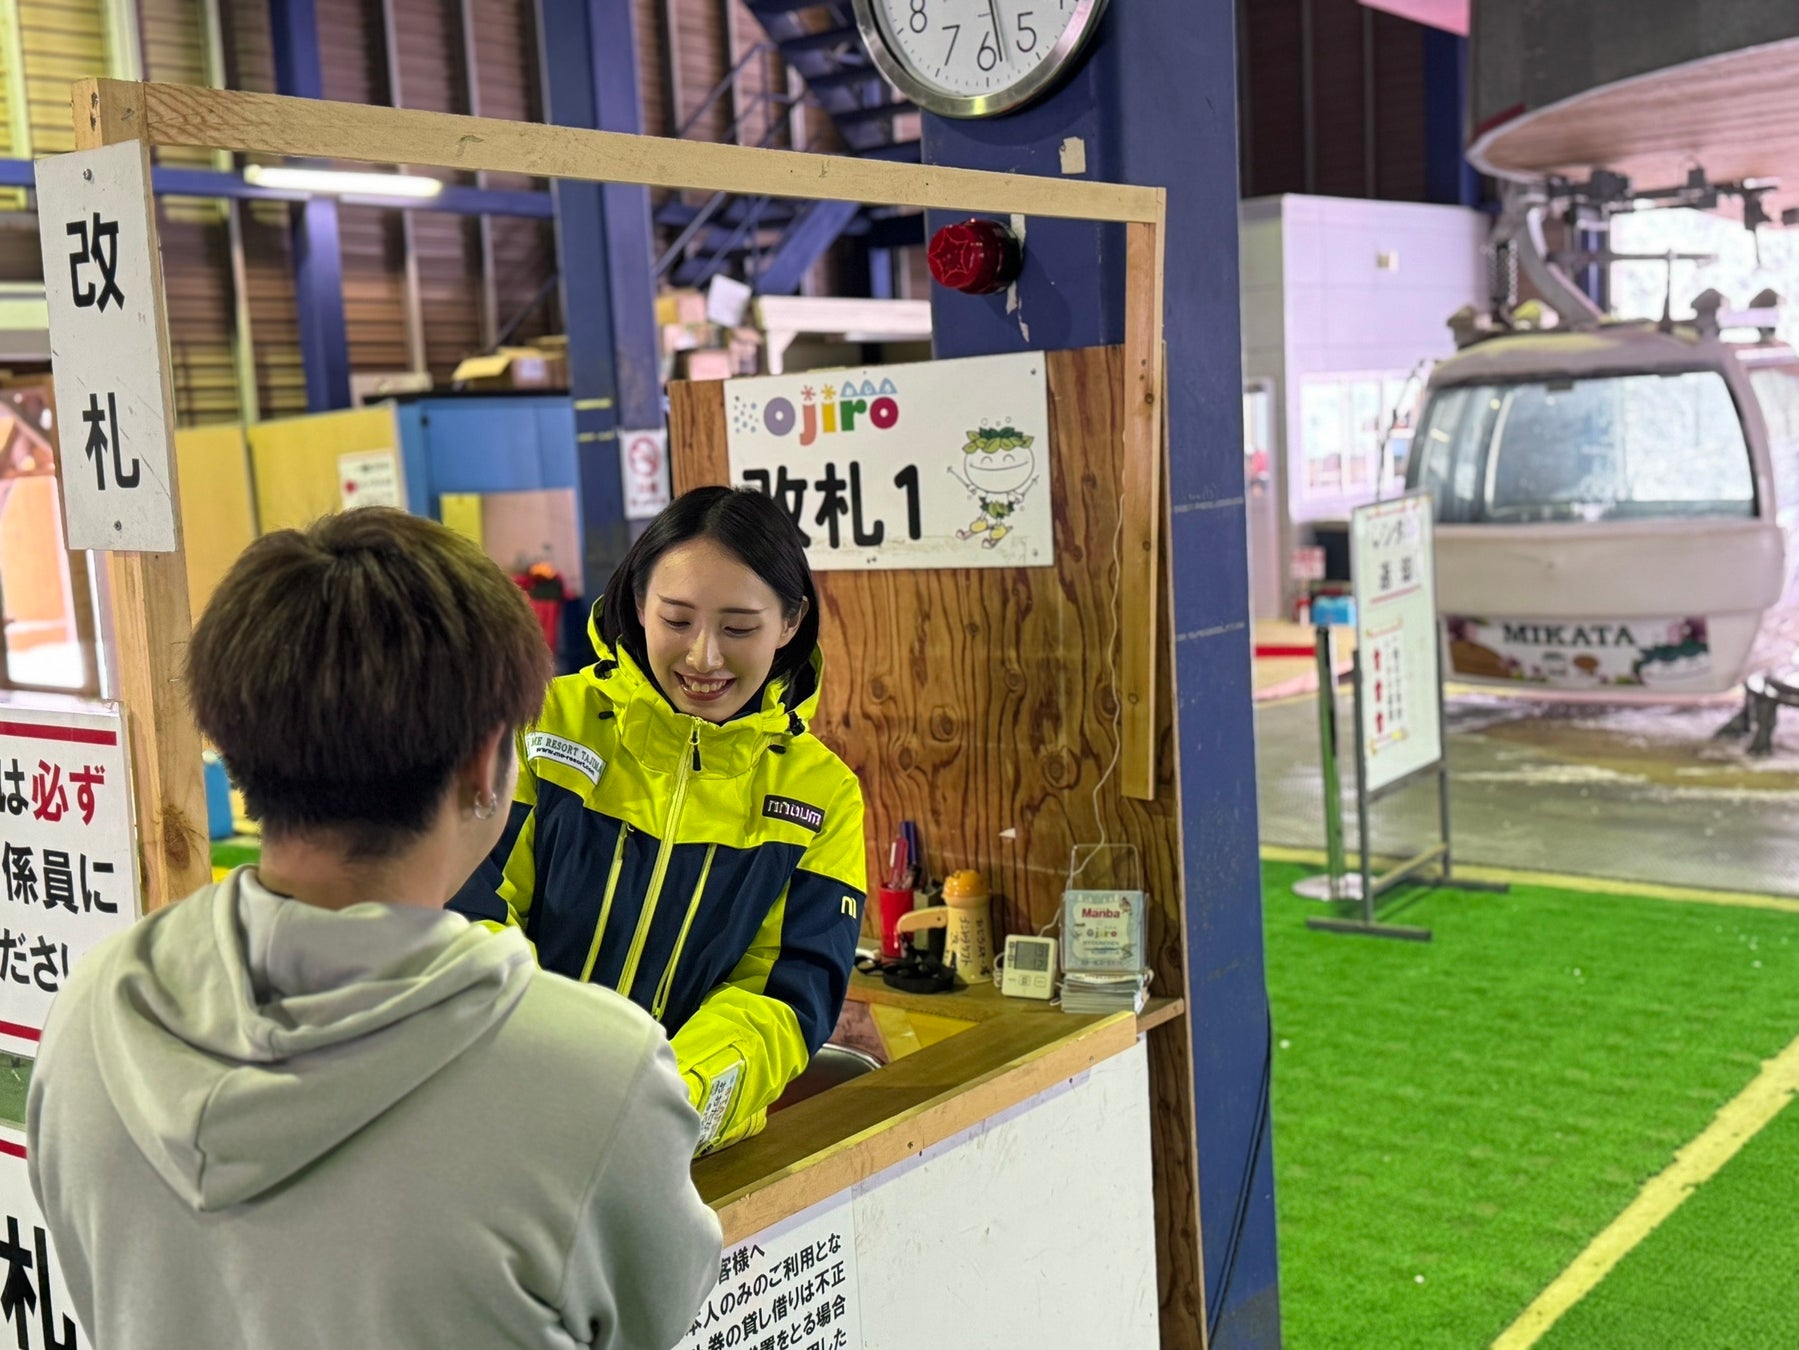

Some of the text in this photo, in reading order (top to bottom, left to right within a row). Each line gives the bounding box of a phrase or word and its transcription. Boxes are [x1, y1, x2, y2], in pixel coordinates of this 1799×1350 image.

[909, 0, 928, 34] 8
[1016, 11, 1037, 53] 5
[942, 24, 961, 67] 7
[976, 31, 997, 72] 6
[66, 211, 141, 492] 改札
[763, 384, 900, 447] ojiro
[1503, 622, 1637, 646] MIKATA
[545, 737, 579, 756] RESORT
[0, 758, 106, 826] は必ず
[1, 841, 119, 915] 係員に
[1081, 907, 1121, 919] Manba
